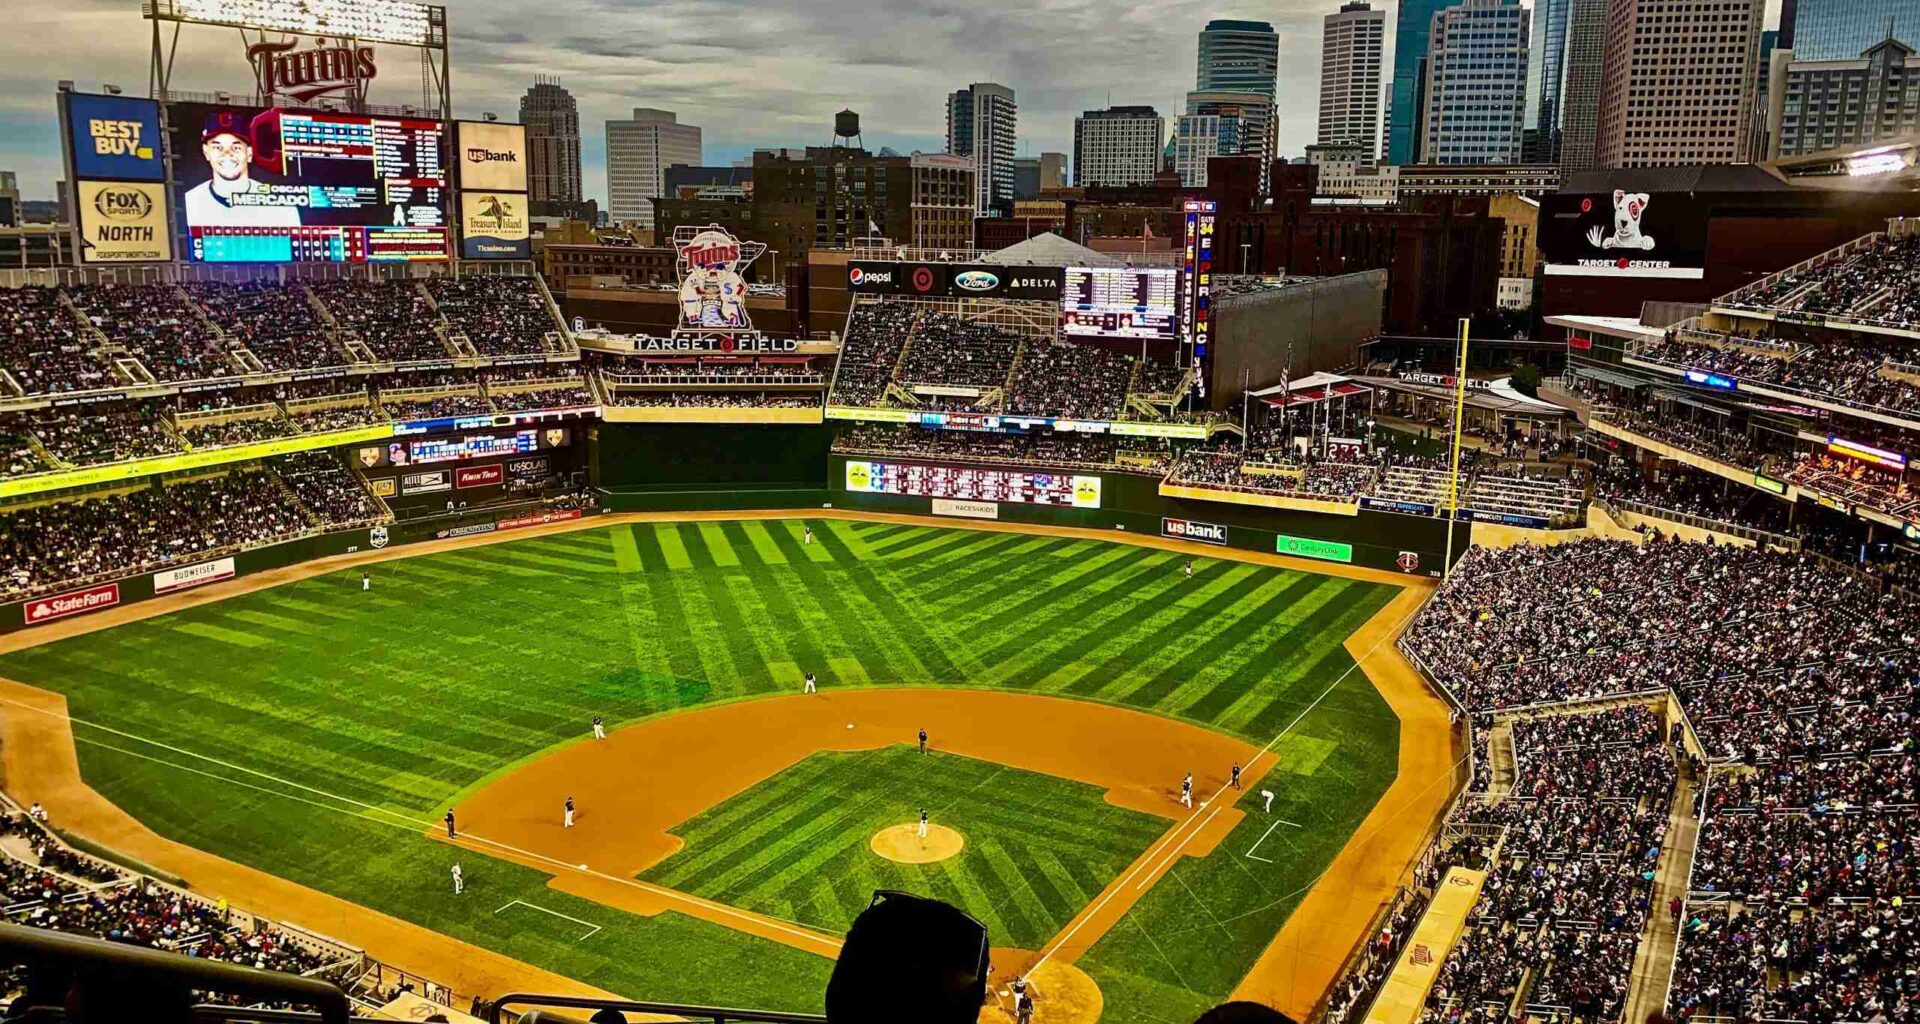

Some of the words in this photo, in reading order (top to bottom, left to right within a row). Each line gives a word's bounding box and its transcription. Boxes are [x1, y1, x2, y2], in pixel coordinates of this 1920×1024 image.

[246, 37, 377, 97] Twins
[89, 119, 143, 139] BEST
[95, 138, 139, 156] BUY
[270, 185, 308, 194] OSCAR
[106, 191, 141, 208] FOX
[233, 194, 309, 206] MERCADO
[107, 207, 142, 216] SPORTS
[503, 218, 521, 229] Island
[1200, 223, 1214, 235] 34
[98, 225, 153, 242] NORTH
[681, 241, 741, 273] Twins
[1577, 258, 1618, 268] TARGET
[1629, 259, 1670, 269] CENTER
[864, 271, 892, 284] pepsi
[964, 273, 990, 288] Ford
[1022, 278, 1057, 288] DELTA
[575, 320, 584, 332] B
[634, 338, 718, 350] TARGET
[738, 339, 798, 351] FIELD
[1398, 372, 1443, 384] TARGET
[462, 473, 482, 482] KWIK
[482, 470, 499, 480] TRIP
[1167, 520, 1224, 540] usbank
[174, 564, 216, 581] BUDWEISER
